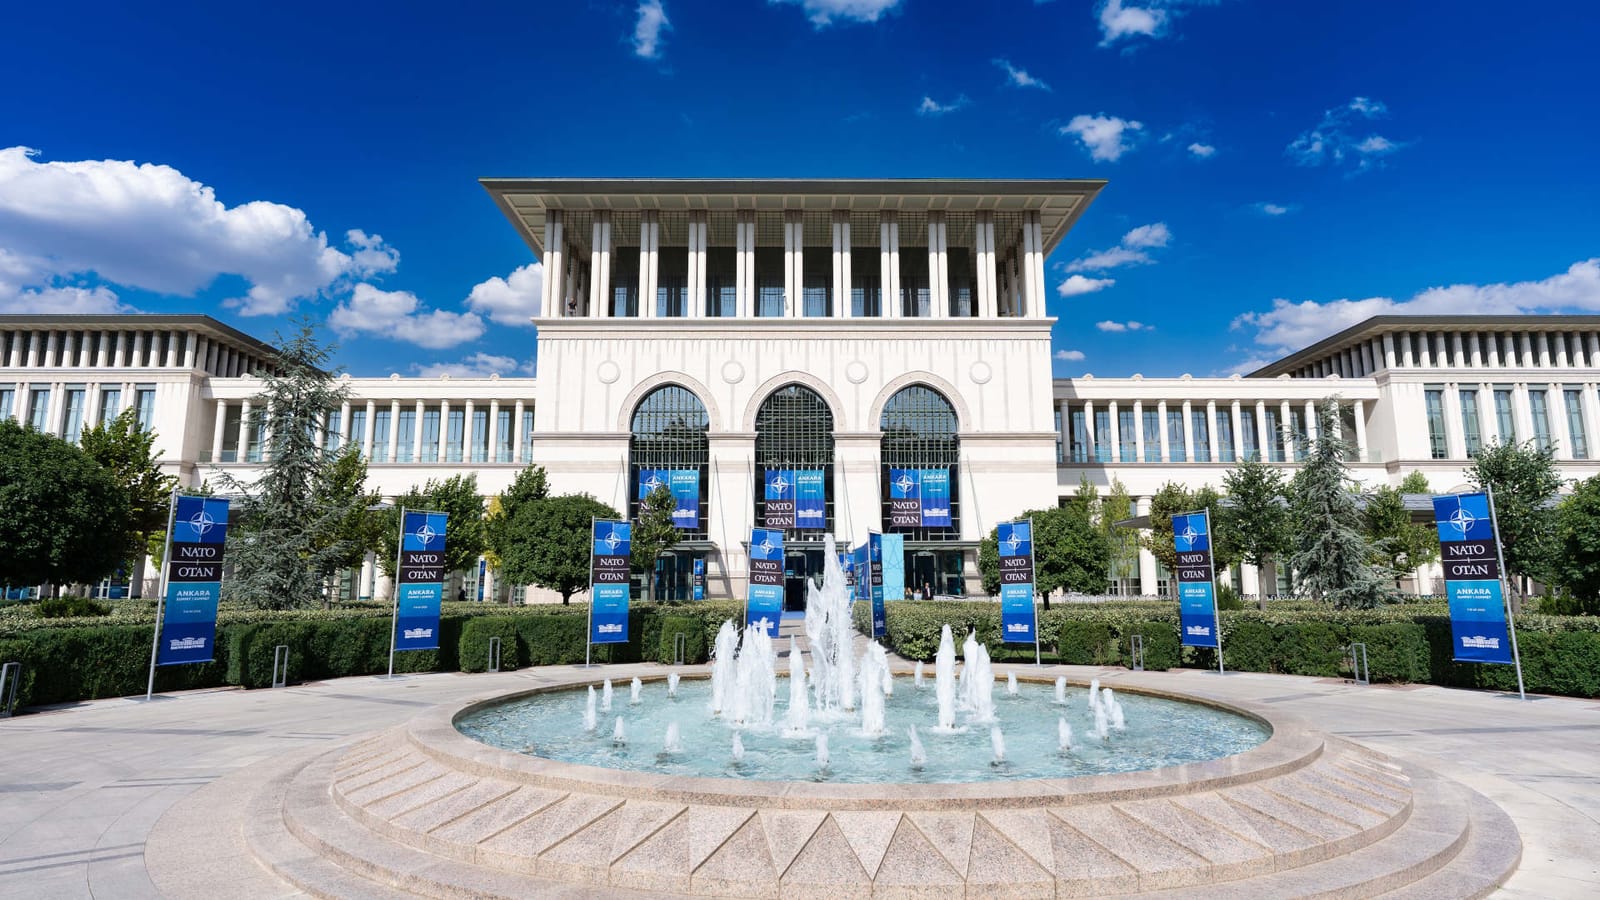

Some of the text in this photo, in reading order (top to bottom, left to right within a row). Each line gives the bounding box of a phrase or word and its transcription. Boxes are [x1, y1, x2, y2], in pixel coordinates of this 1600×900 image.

[767, 502, 793, 511] NATO
[892, 501, 918, 509] NATO
[766, 517, 793, 526] OTAN
[893, 516, 919, 524] OTAN
[181, 547, 216, 557] NATO
[1449, 544, 1485, 556] NATO
[410, 555, 437, 563] NATO
[600, 558, 625, 566] NATO
[1004, 558, 1026, 567] NATO
[1181, 554, 1204, 563] NATO
[755, 561, 777, 570] NATO
[1452, 564, 1489, 576] OTAN
[178, 566, 214, 577] OTAN
[408, 571, 436, 579] OTAN
[1182, 570, 1205, 579] OTAN
[599, 572, 624, 581] OTAN
[754, 574, 777, 583] OTAN
[1005, 573, 1027, 581] OTAN
